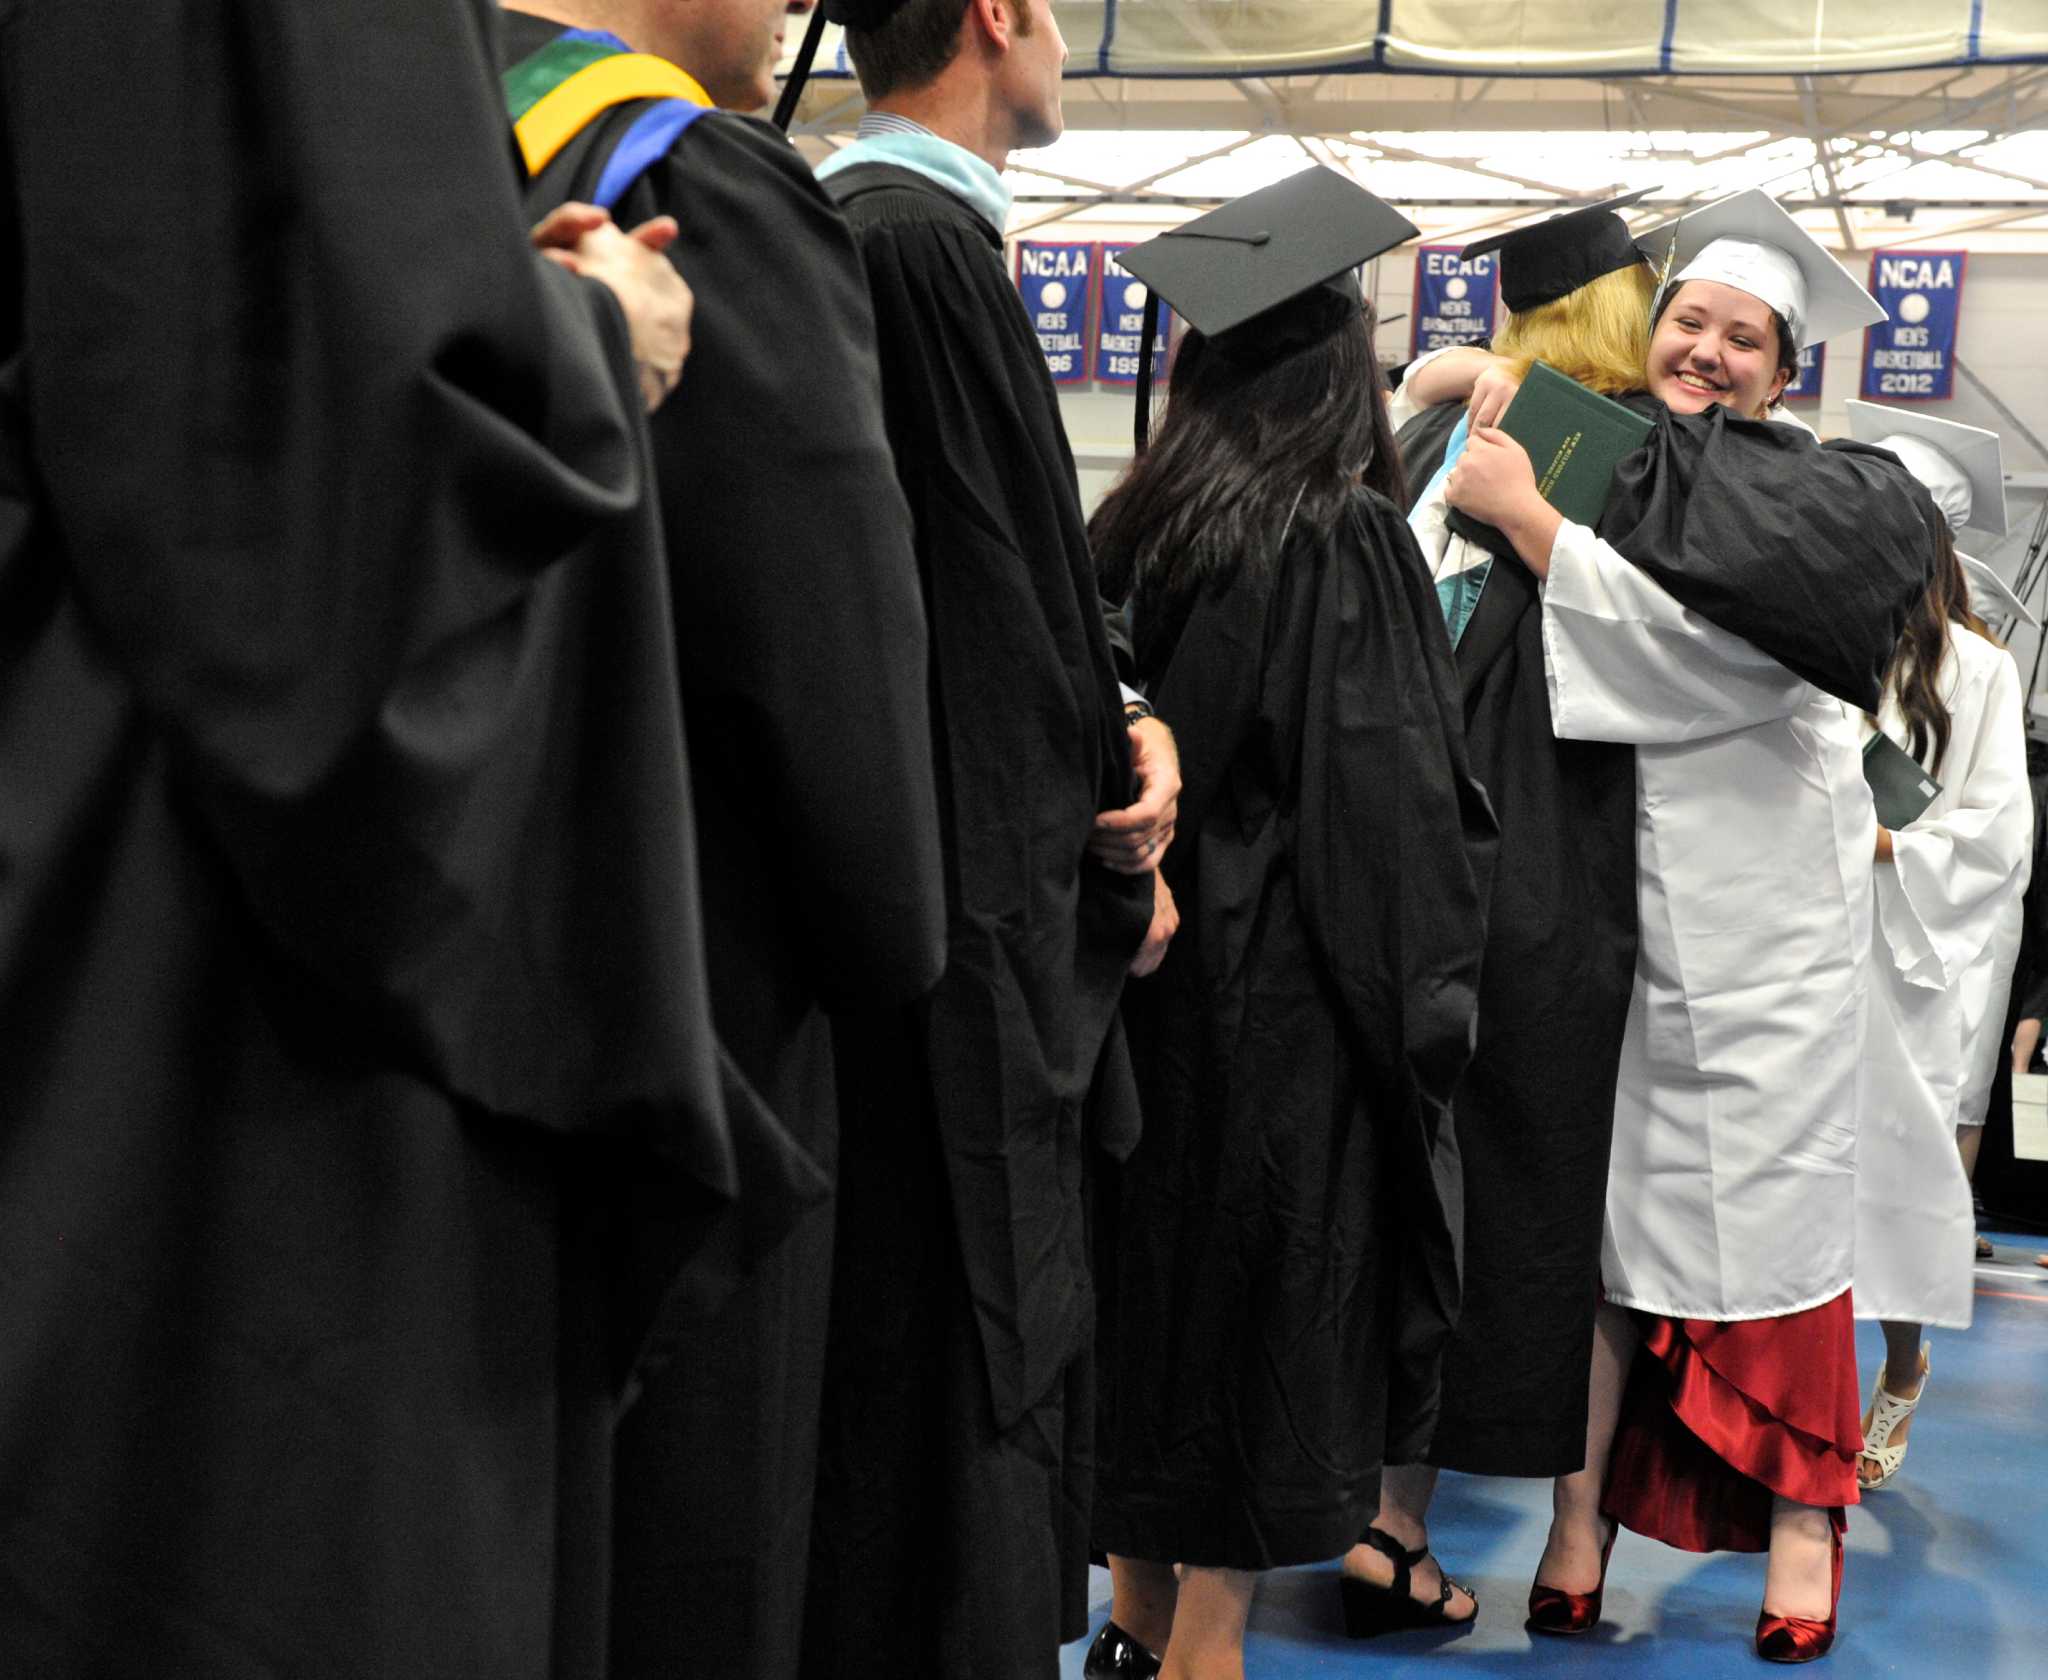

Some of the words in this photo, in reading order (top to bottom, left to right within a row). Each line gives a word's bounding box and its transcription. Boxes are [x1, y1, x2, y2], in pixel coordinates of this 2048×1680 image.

[1022, 249, 1088, 277] NCAA
[1427, 254, 1490, 276] ECAC
[1879, 259, 1954, 288] NCAA
[1119, 313, 1144, 331] MEN
[1108, 356, 1140, 374] 199
[1872, 350, 1943, 369] BASKETBALL
[1880, 373, 1933, 393] 2012
